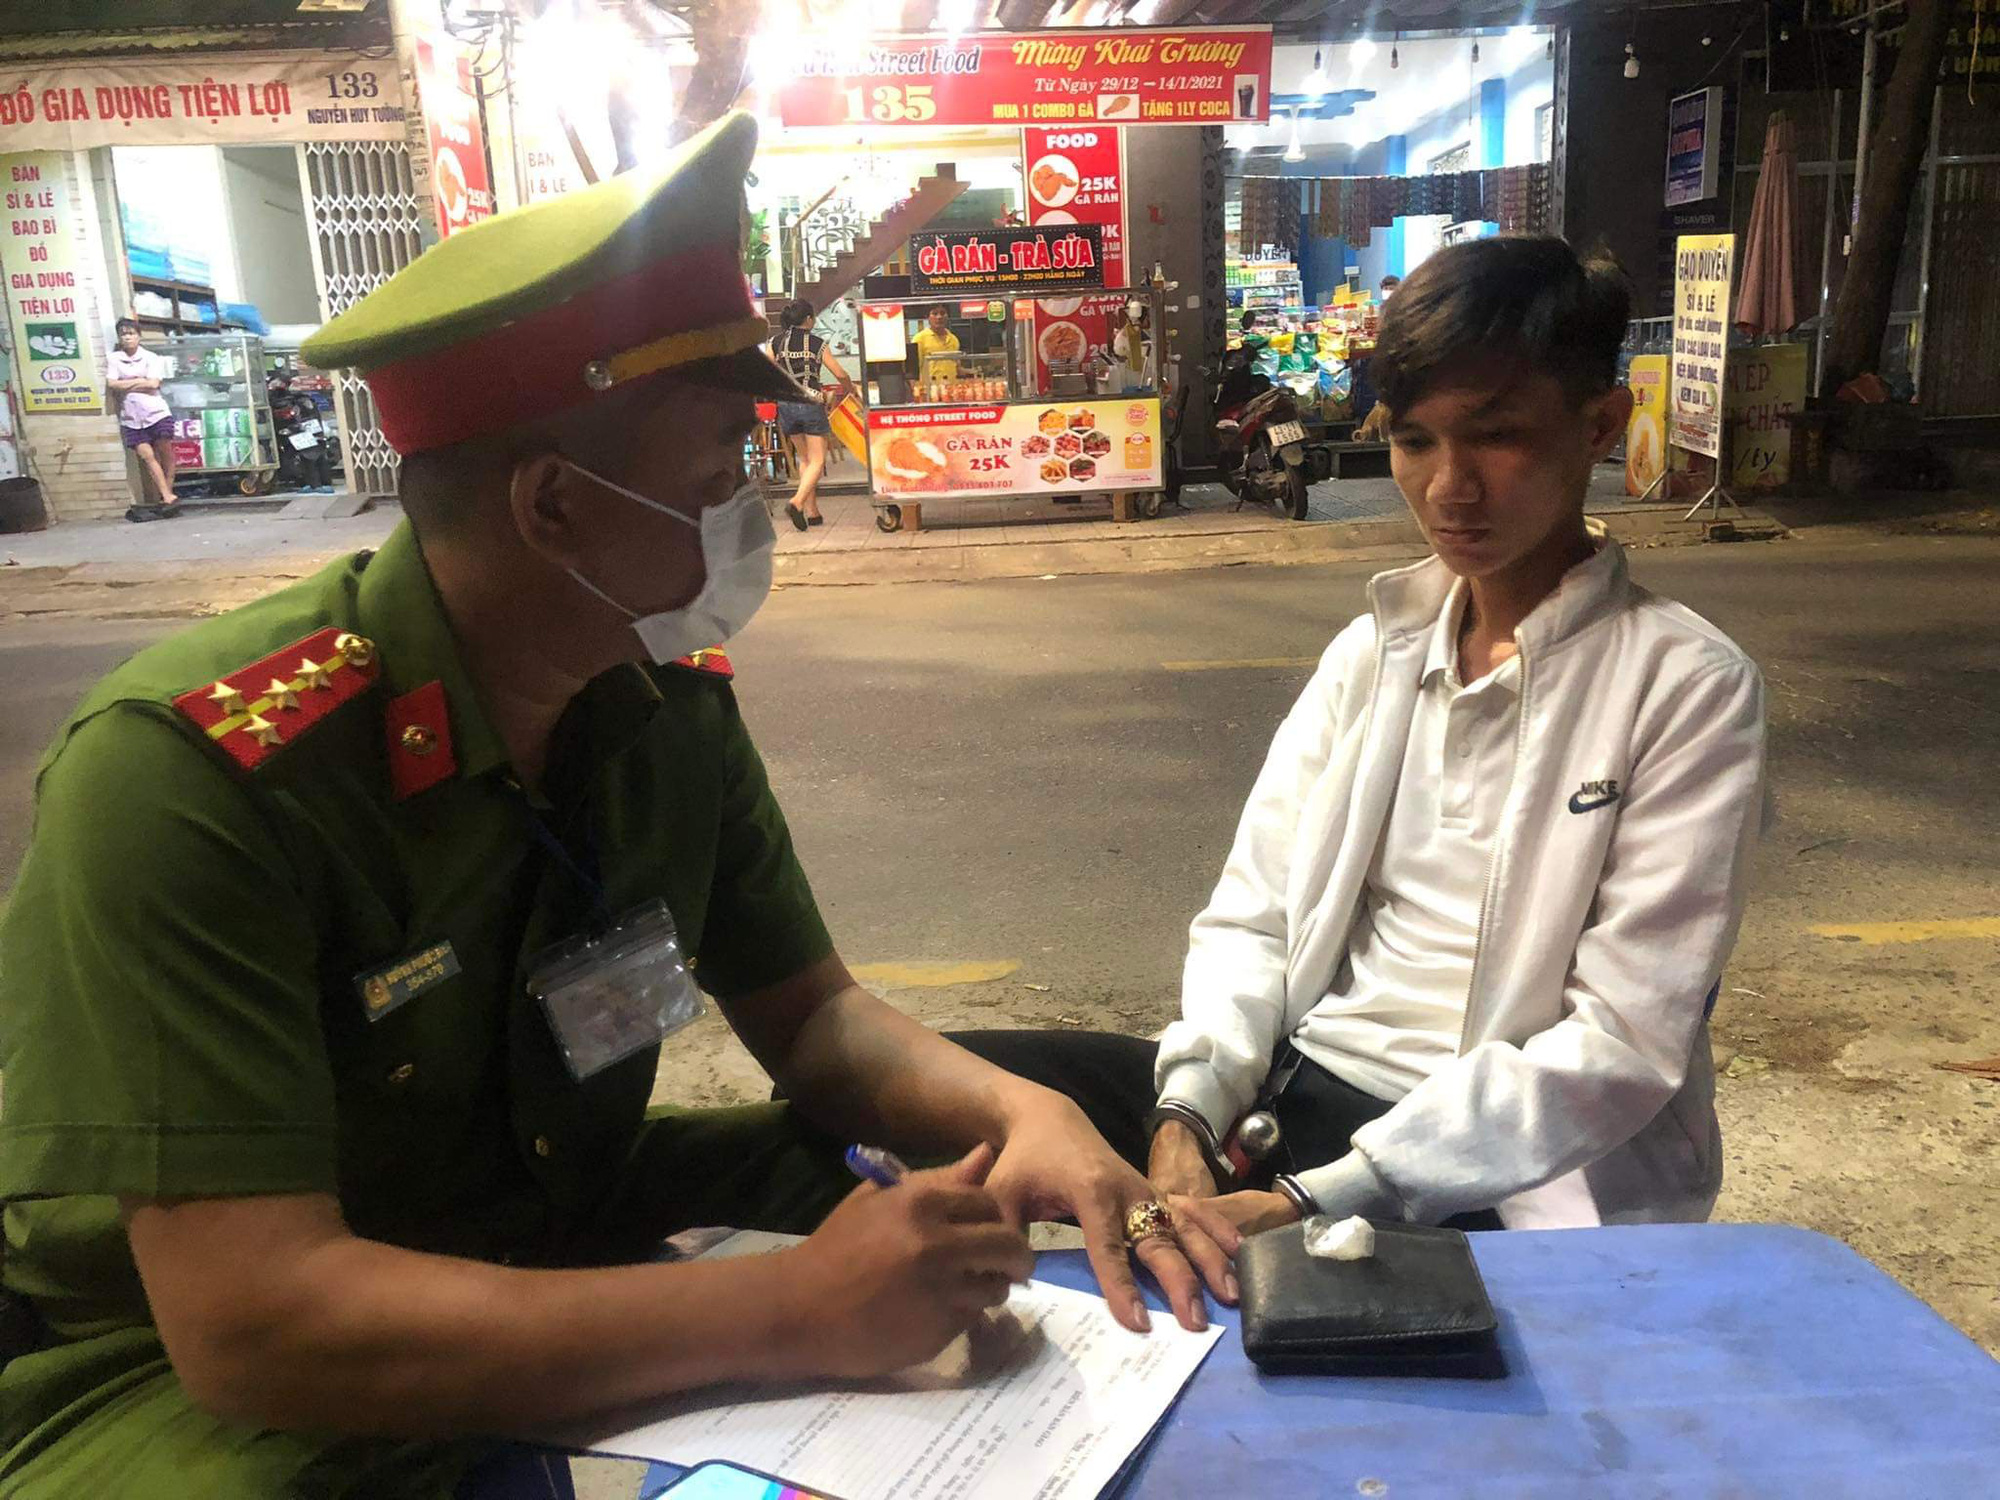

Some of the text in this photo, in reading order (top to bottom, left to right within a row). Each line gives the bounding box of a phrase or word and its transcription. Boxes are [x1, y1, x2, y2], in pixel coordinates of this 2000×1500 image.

[932, 45, 981, 73] Food
[1012, 38, 1085, 71] Mừng
[1095, 39, 1151, 65] Khai
[326, 72, 378, 98] 133
[1034, 77, 1054, 92] Từ
[1057, 80, 1097, 94] Ngày
[1101, 76, 1139, 91] 29/12
[1159, 75, 1223, 90] 14/1/2021
[42, 87, 90, 122] GIA
[95, 85, 172, 126] DỤNG
[177, 77, 240, 124] TIỆN
[247, 81, 291, 123] LỢI
[845, 84, 936, 121] 135
[993, 104, 1019, 118] MUA
[1023, 104, 1028, 118] 1
[1033, 103, 1075, 118] COMBO
[1078, 101, 1094, 117] GÀ
[1143, 100, 1175, 119] TẶNG
[1199, 101, 1230, 116] COCA
[350, 108, 369, 123] HUY
[1046, 133, 1098, 149] FOOD
[1081, 176, 1117, 191] 25K
[25, 193, 34, 209] &
[12, 219, 39, 236] BAO
[918, 237, 951, 275] GÀ
[952, 236, 997, 273] RÁN
[1011, 234, 1052, 270] TRÀ
[1052, 232, 1095, 267] SỮA
[11, 272, 75, 291] GIA DỤNG
[934, 412, 966, 422] STREET
[969, 411, 996, 420] FOOD
[947, 435, 1012, 451] GÀ RÁN
[970, 455, 1010, 471] 25K
